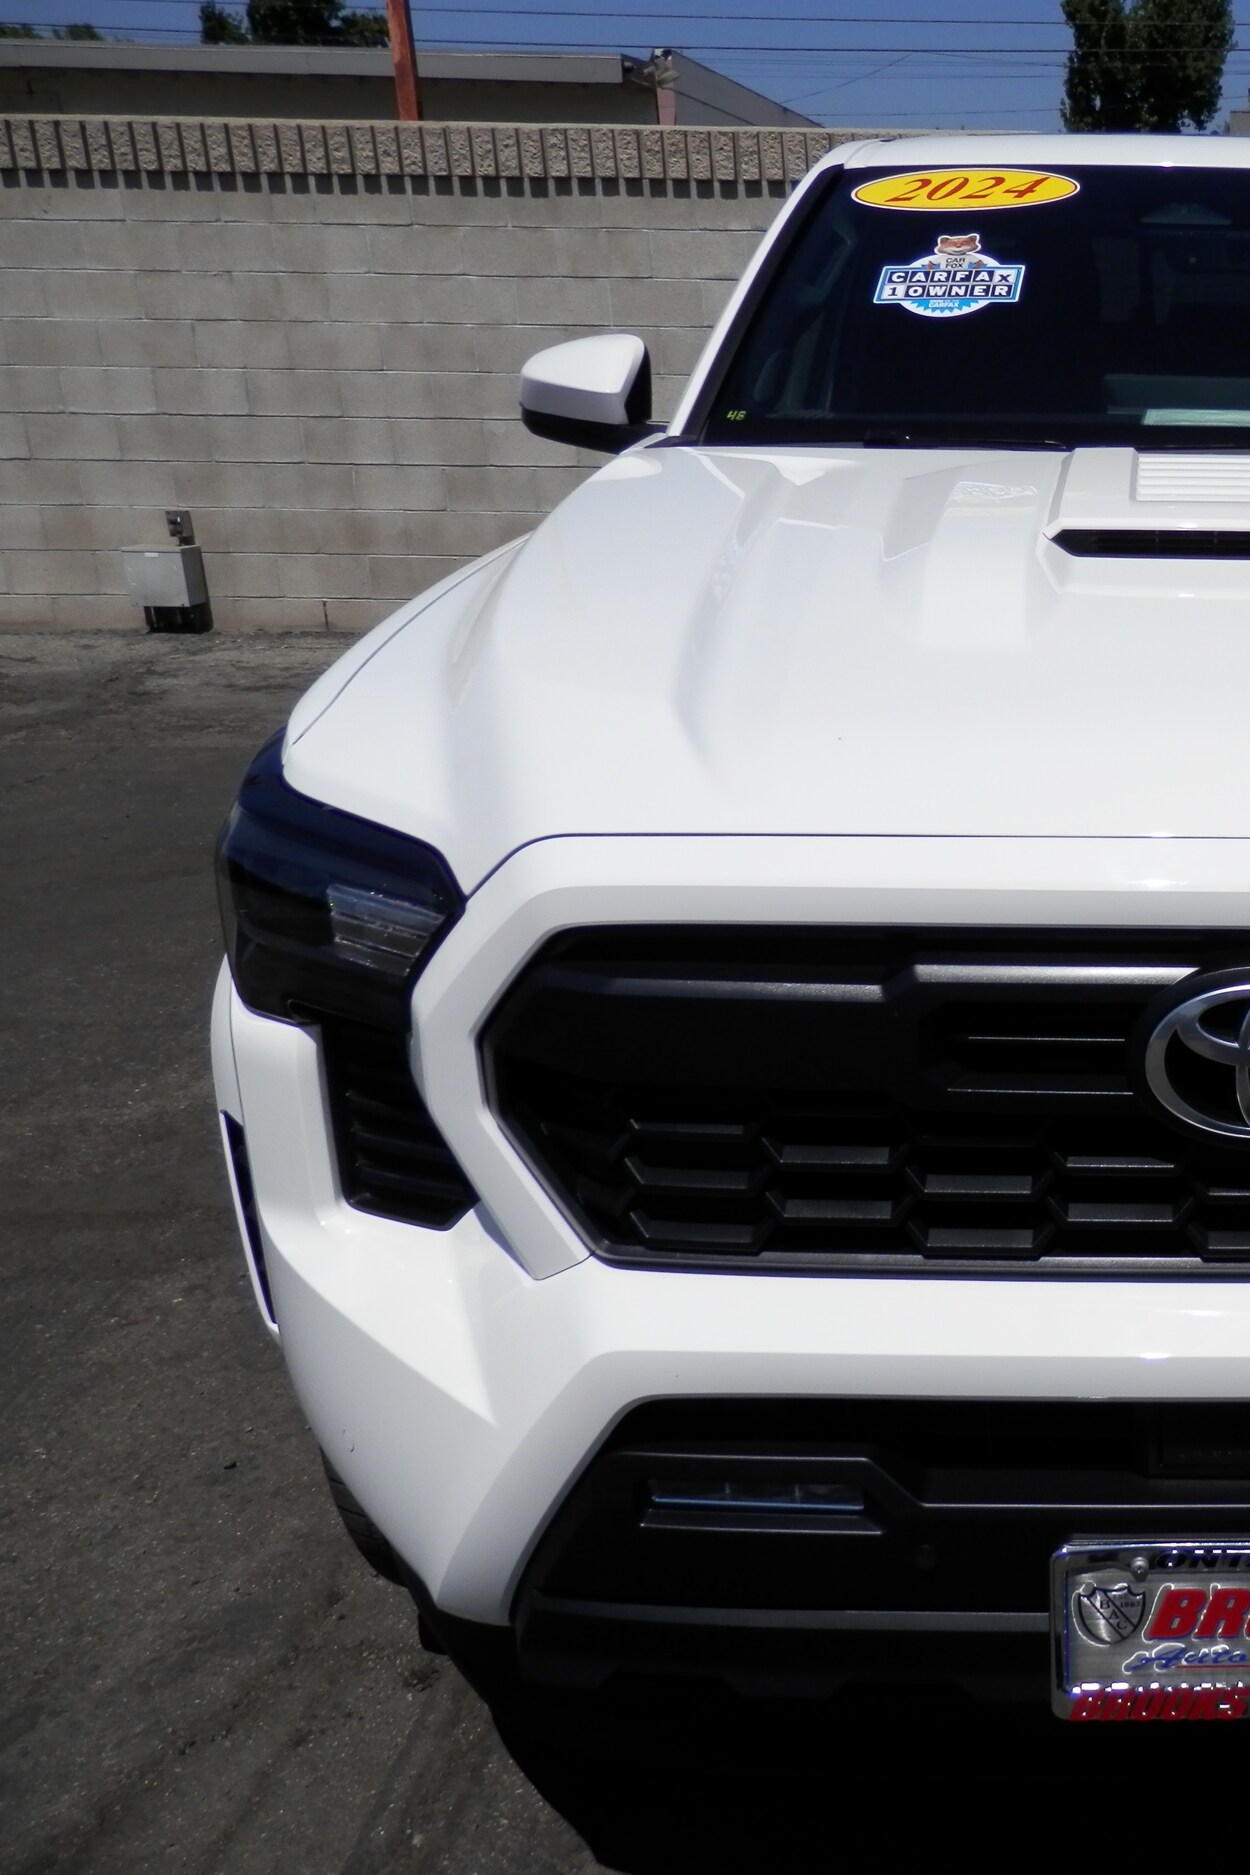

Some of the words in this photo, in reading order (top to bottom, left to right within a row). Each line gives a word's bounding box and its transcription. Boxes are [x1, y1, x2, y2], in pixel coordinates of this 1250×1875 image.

[884, 176, 1050, 203] 2024
[891, 271, 1012, 283] CARFAX
[888, 287, 898, 296] 1
[908, 285, 1008, 297] OWNER
[1124, 1644, 1248, 1673] Auto
